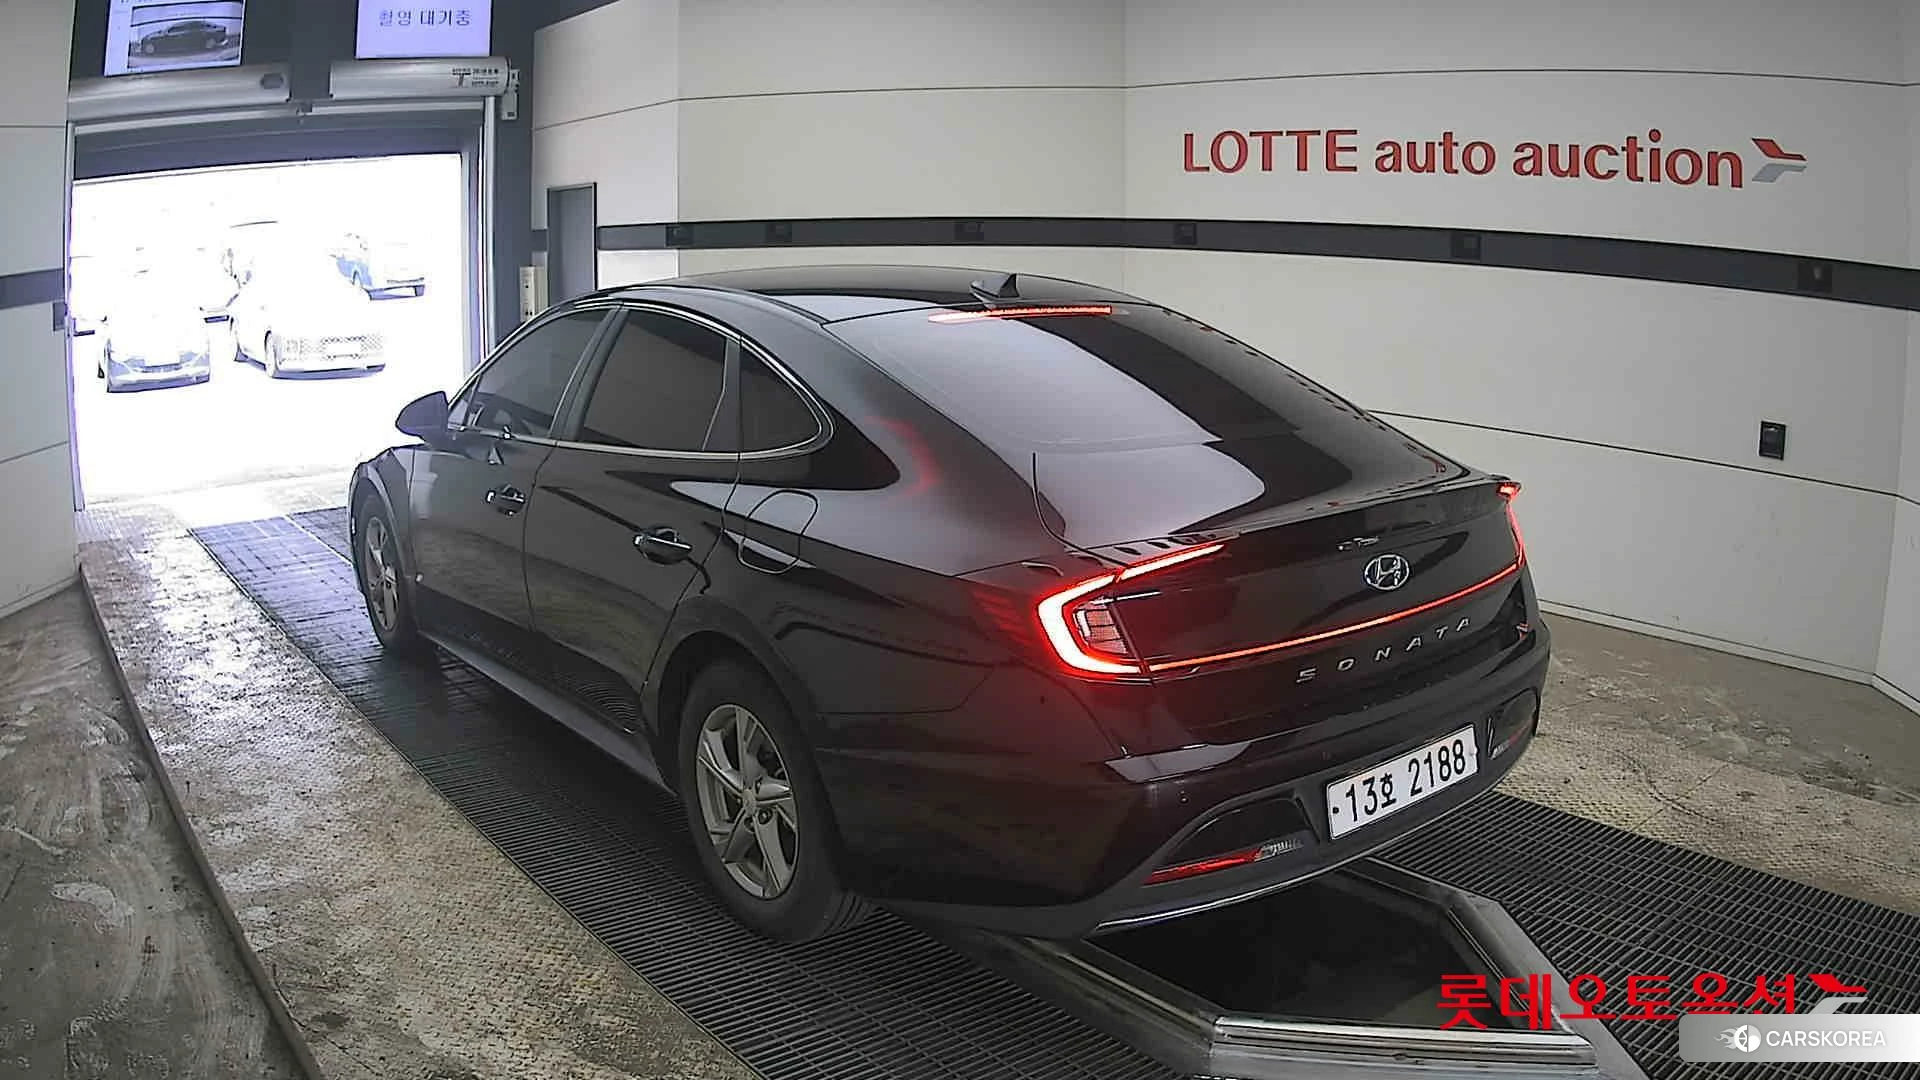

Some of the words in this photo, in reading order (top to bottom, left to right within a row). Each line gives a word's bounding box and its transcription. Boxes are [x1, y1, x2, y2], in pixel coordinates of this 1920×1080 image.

[420, 9, 470, 26] 대기중
[1184, 129, 1358, 173] LOTTE
[1375, 131, 1496, 175] auto
[1512, 128, 1744, 188] auction
[1296, 618, 1470, 683] SONATA
[1345, 773, 1397, 822] 13호
[1408, 739, 1466, 797] 2188
